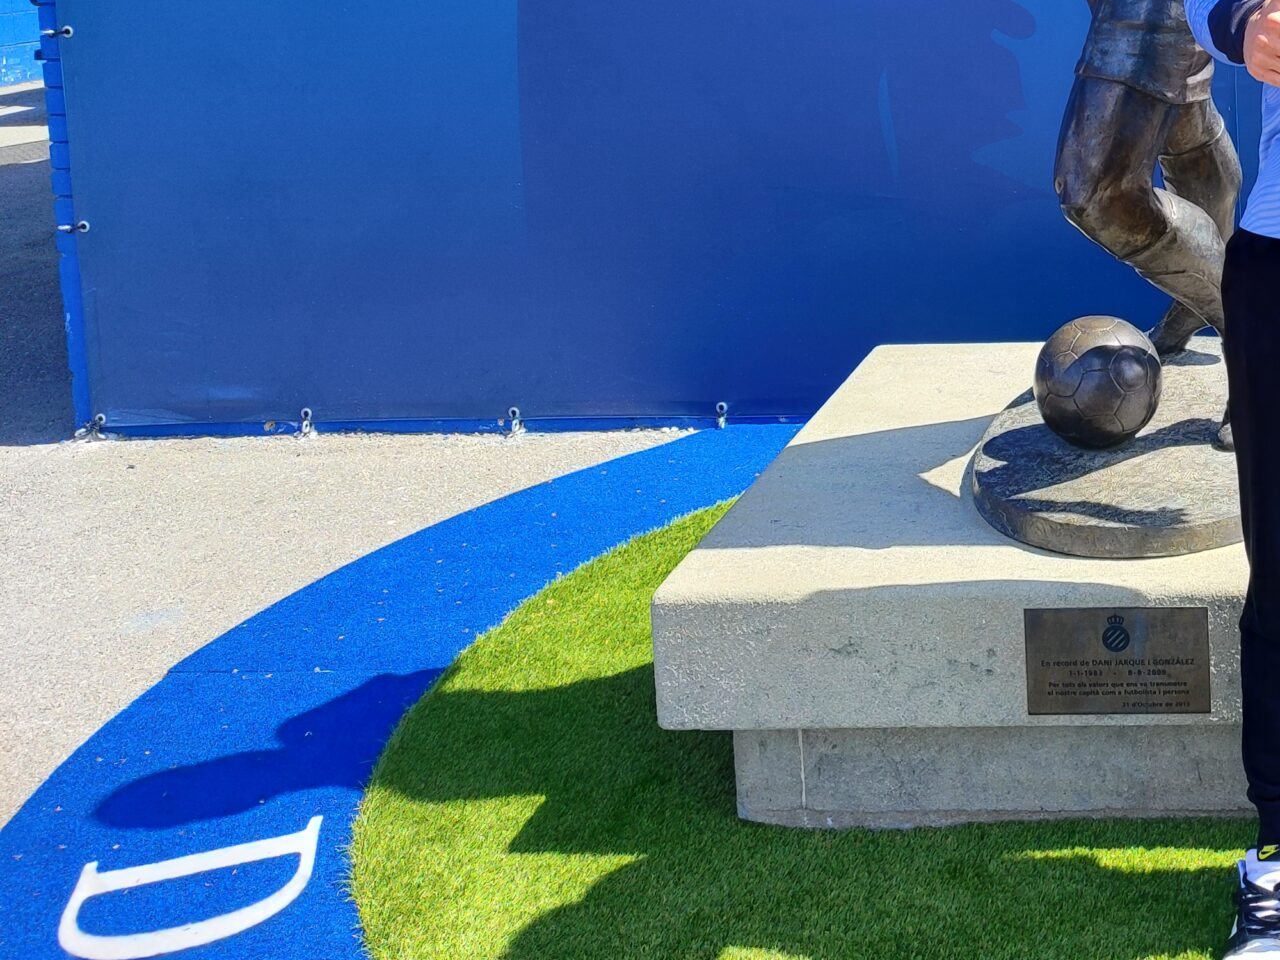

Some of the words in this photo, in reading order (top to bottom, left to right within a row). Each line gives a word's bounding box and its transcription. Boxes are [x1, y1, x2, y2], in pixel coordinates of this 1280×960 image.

[1052, 659, 1078, 667] record
[1079, 659, 1090, 667] de
[1114, 658, 1146, 667] JARQUE
